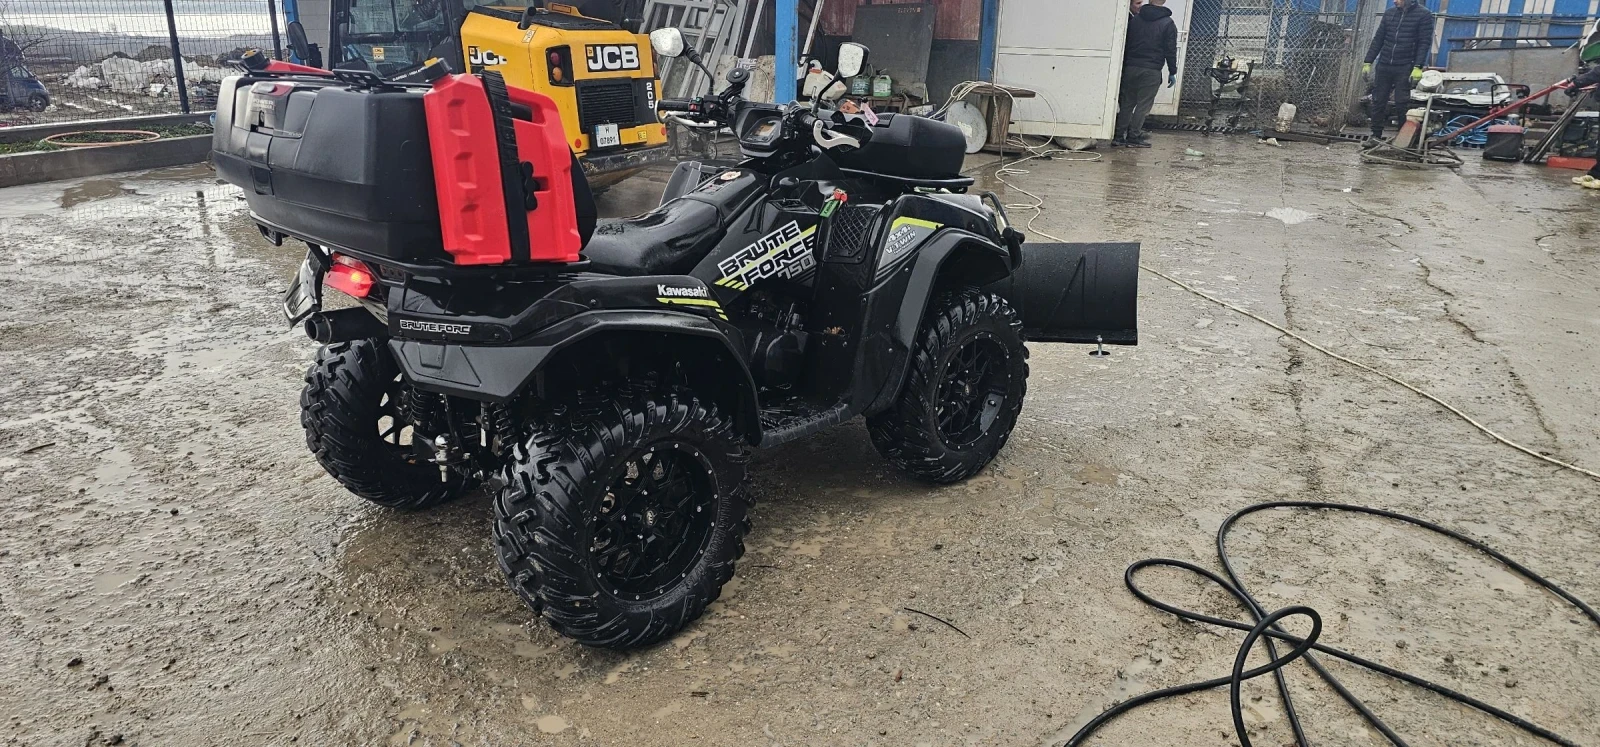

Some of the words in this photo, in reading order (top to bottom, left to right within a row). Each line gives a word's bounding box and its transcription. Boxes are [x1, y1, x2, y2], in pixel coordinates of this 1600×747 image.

[587, 45, 639, 70] JCB
[646, 82, 654, 108] 205
[717, 220, 802, 278] BRUTE
[741, 235, 815, 288] FORCE
[777, 252, 817, 280] 750
[657, 284, 708, 298] Kawasaki
[399, 319, 437, 332] BRUTE
[437, 323, 472, 335] FORC
